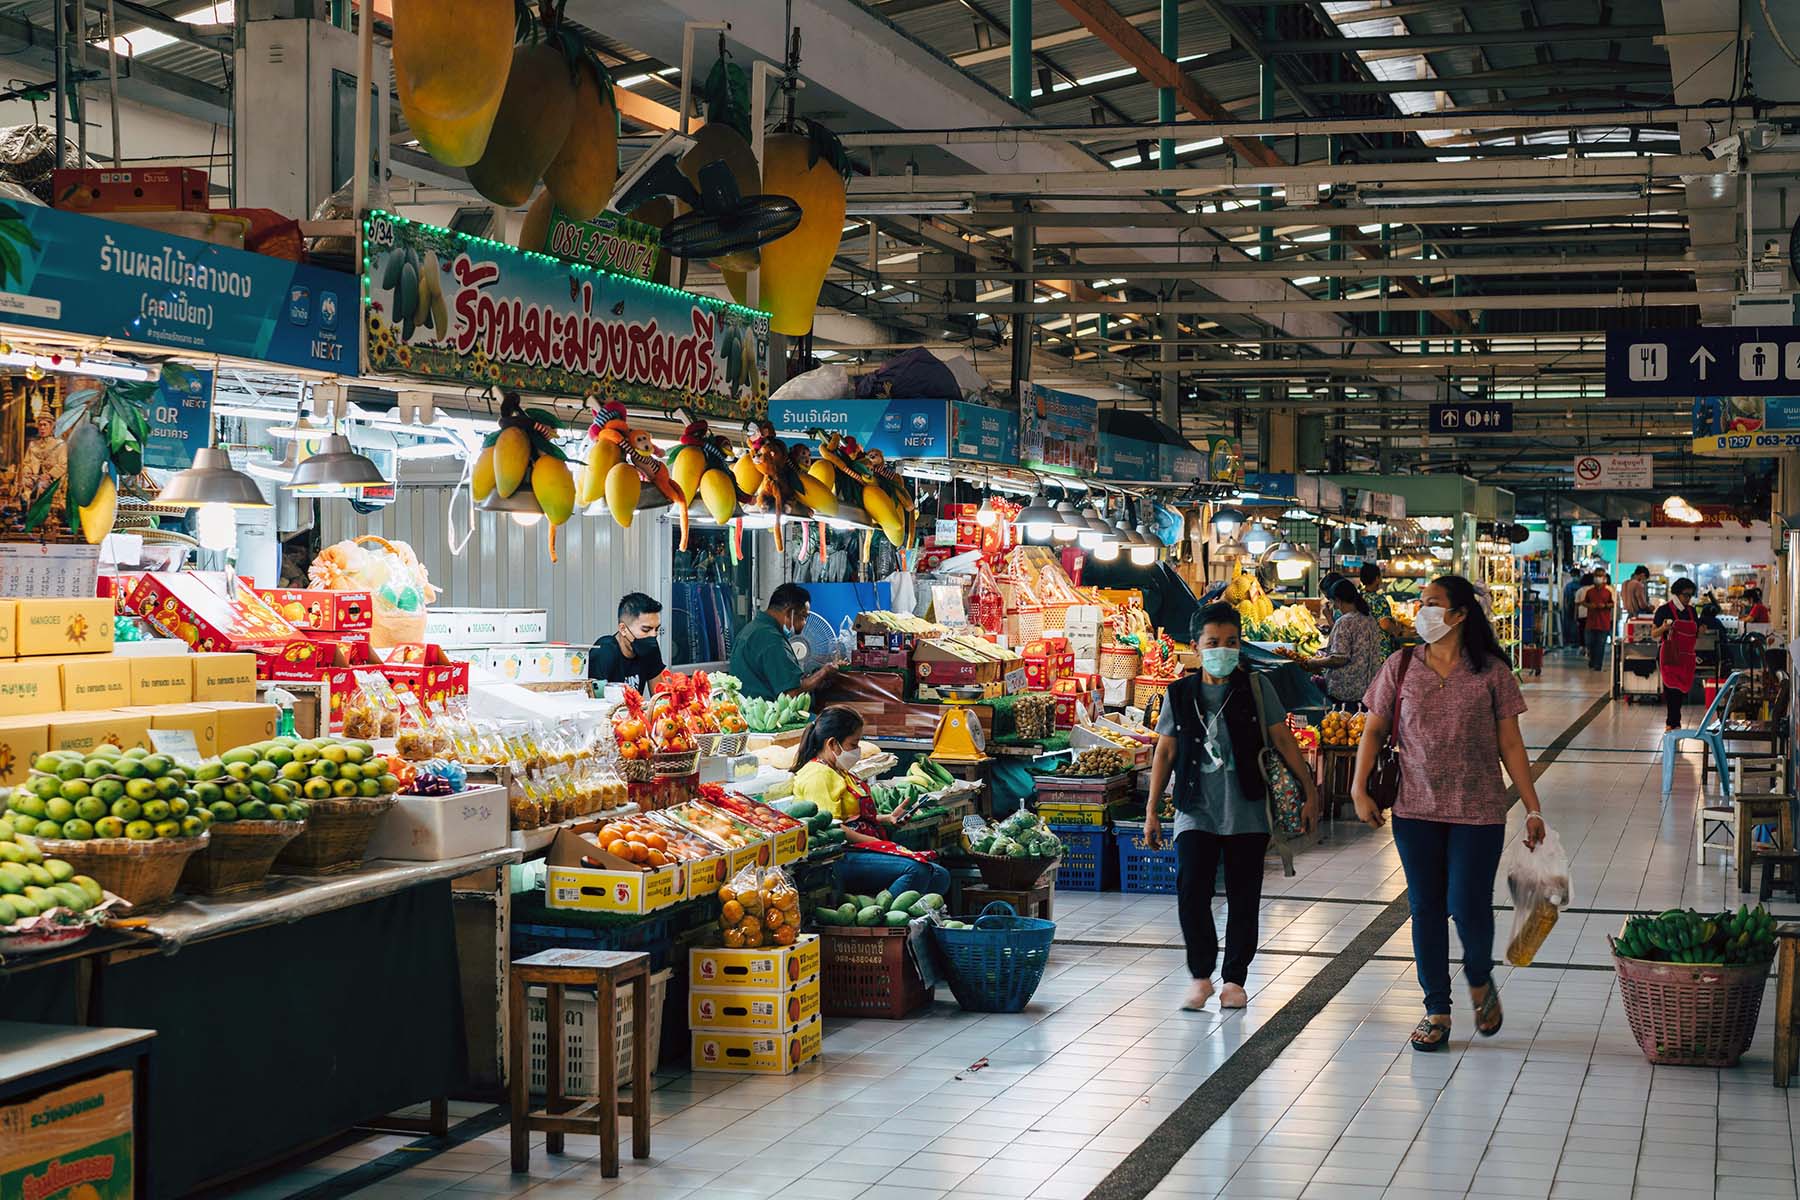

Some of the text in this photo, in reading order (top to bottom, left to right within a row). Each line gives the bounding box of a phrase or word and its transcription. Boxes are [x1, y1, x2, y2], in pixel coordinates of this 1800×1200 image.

[552, 221, 654, 277] 081-2790074
[455, 255, 715, 395] ร้านมะม่วงสมศรี
[311, 340, 343, 361] NEXT
[182, 399, 208, 409] NEXT
[156, 406, 178, 424] QR
[783, 409, 848, 424] ร้านเจ๊เผือก
[904, 437, 935, 447] NEXT
[1729, 436, 1751, 447] 1297
